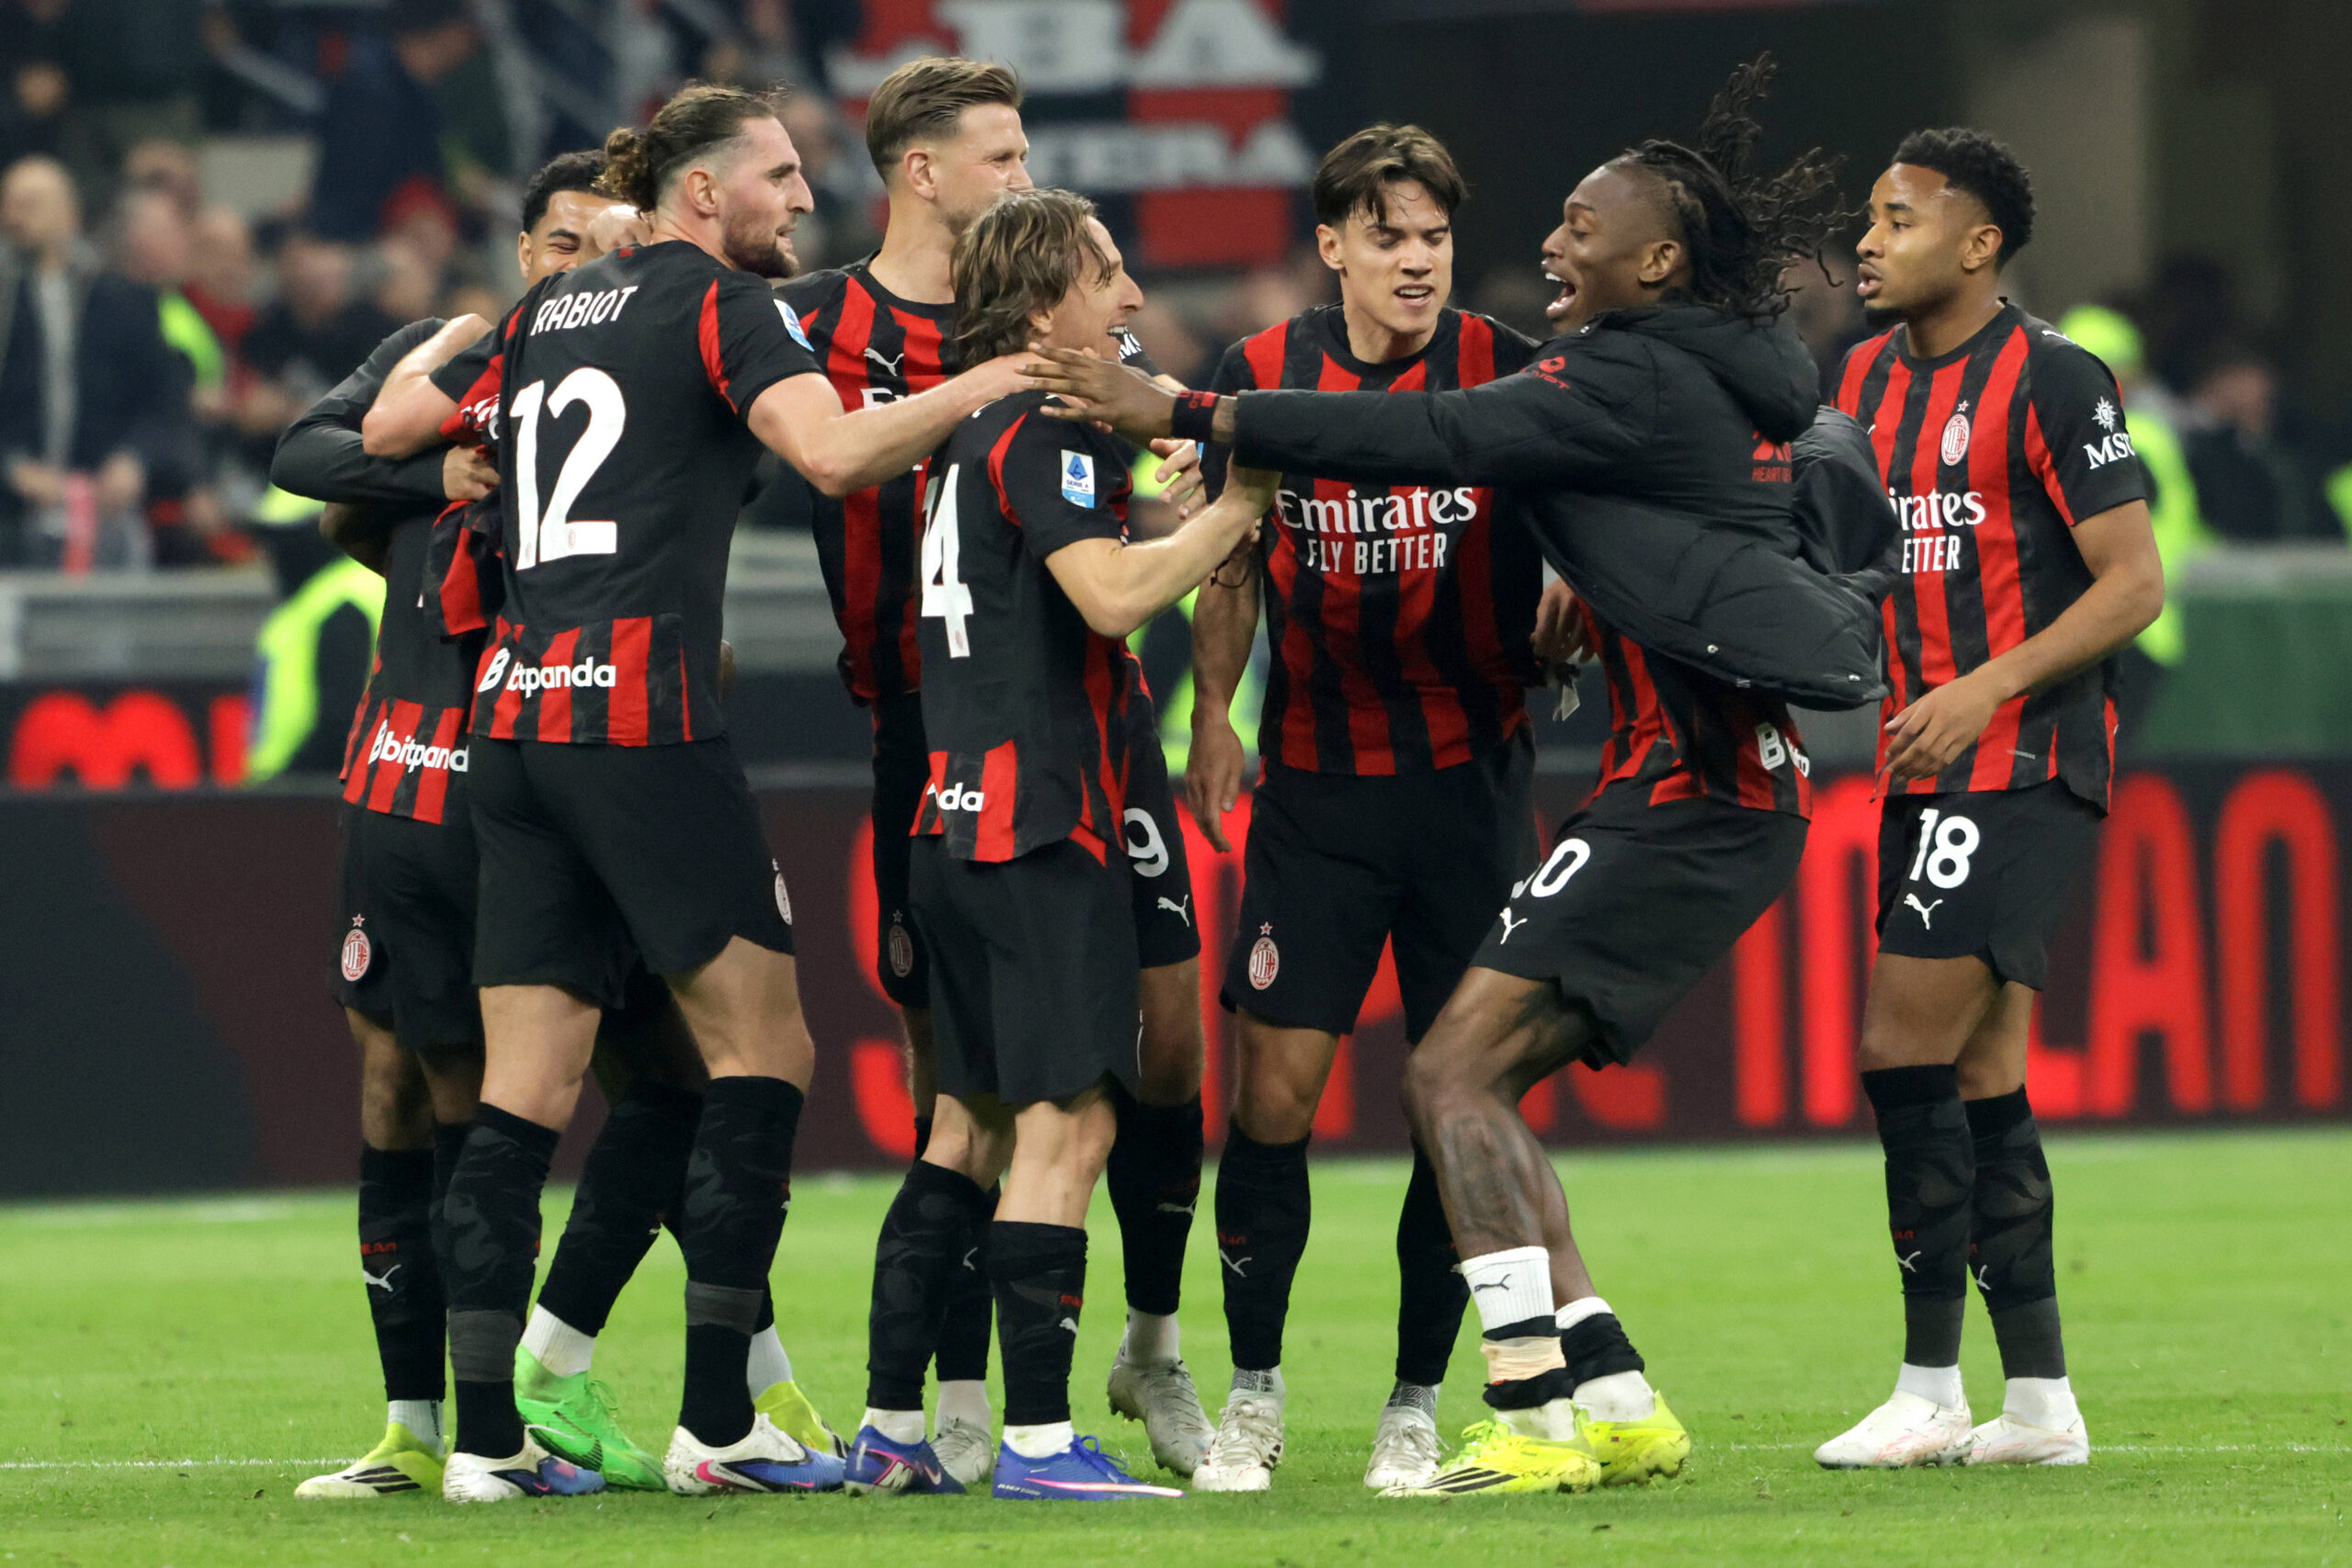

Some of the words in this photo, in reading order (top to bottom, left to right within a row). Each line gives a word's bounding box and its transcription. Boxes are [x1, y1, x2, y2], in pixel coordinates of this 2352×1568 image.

[530, 286, 639, 337] RABIOT
[509, 366, 626, 570] 12
[1275, 486, 1477, 535] Emirates
[1888, 487, 1986, 531] irates
[1306, 538, 1344, 573] FLY
[1353, 532, 1447, 574] BETTER
[1902, 535, 1961, 573] ETTER
[379, 731, 469, 773] bitpand
[1909, 807, 1980, 889] 18
